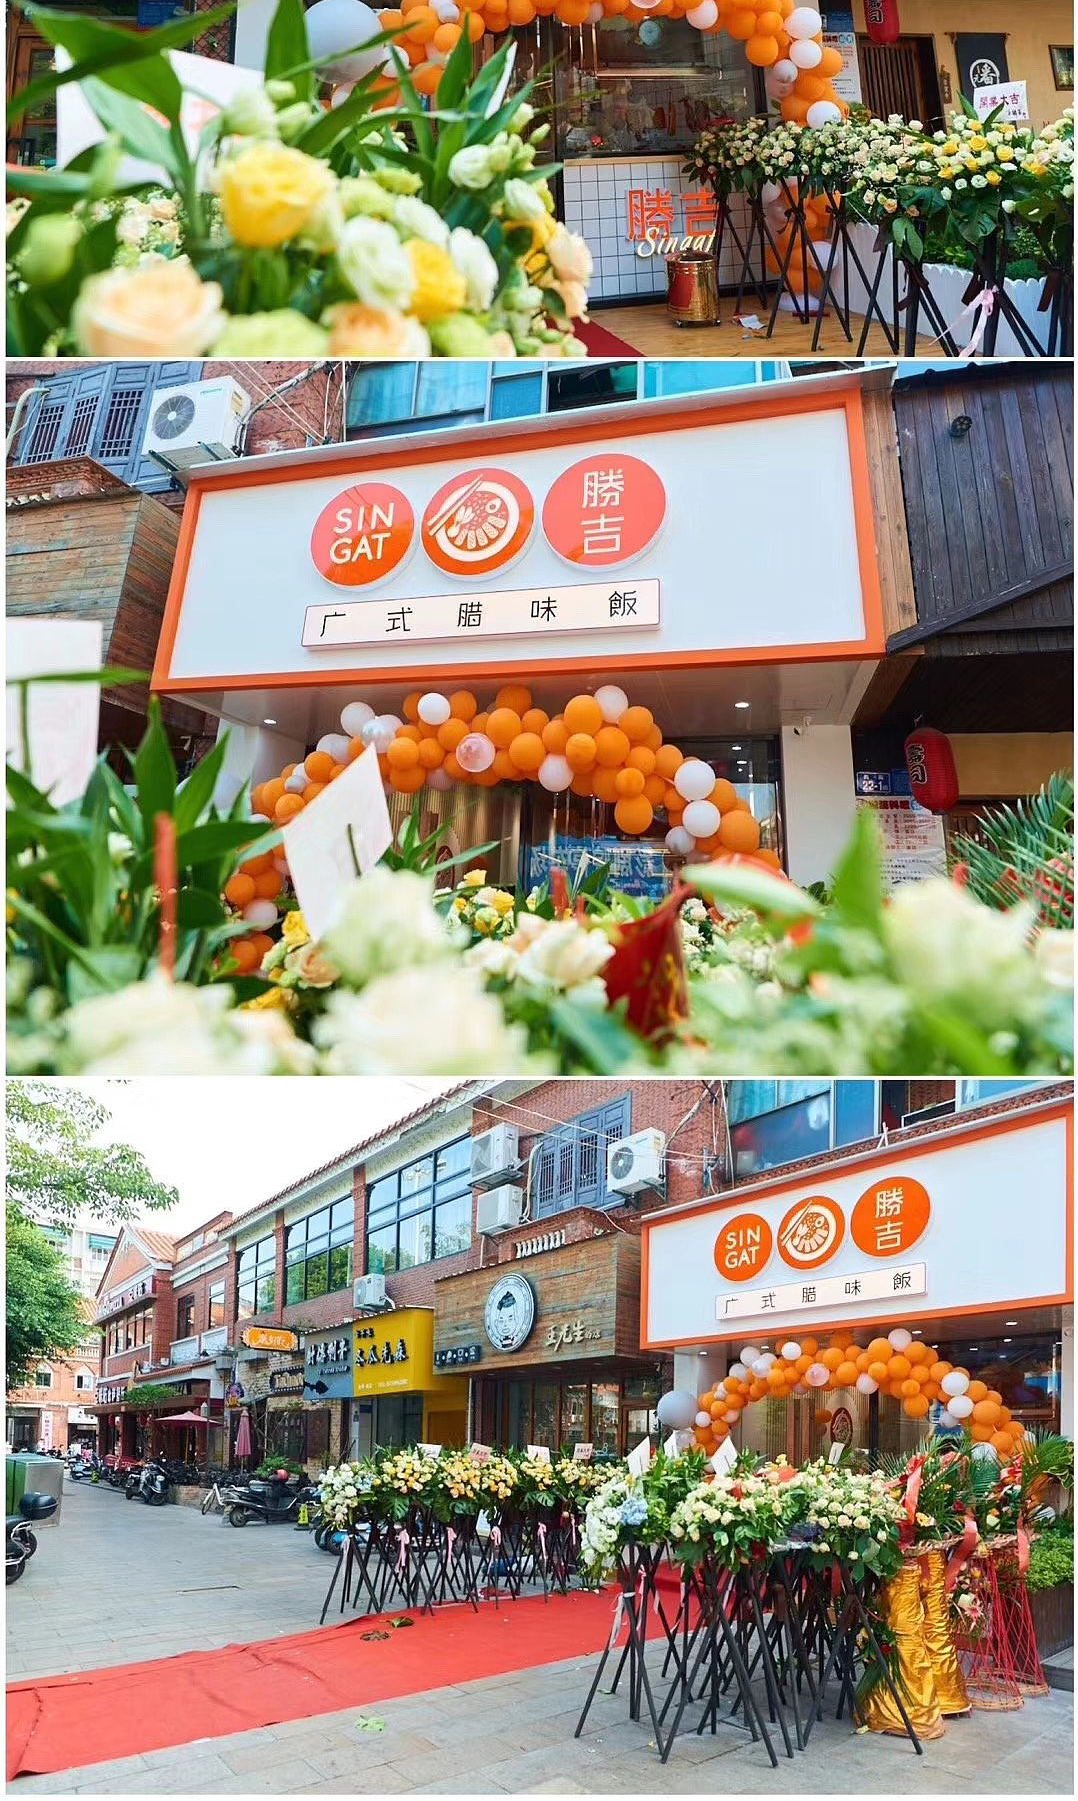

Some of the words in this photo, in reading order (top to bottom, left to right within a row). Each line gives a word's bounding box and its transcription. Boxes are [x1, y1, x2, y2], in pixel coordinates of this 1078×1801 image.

[333, 502, 395, 535] SIN
[580, 467, 625, 556] 勝吉
[329, 531, 392, 564] GAT
[320, 590, 638, 638] 广式腊味飯
[725, 1225, 762, 1249] SIN
[874, 1187, 904, 1251] 勝吉
[724, 1246, 760, 1269] GAT
[724, 1271, 912, 1315] 广式腊味飯
